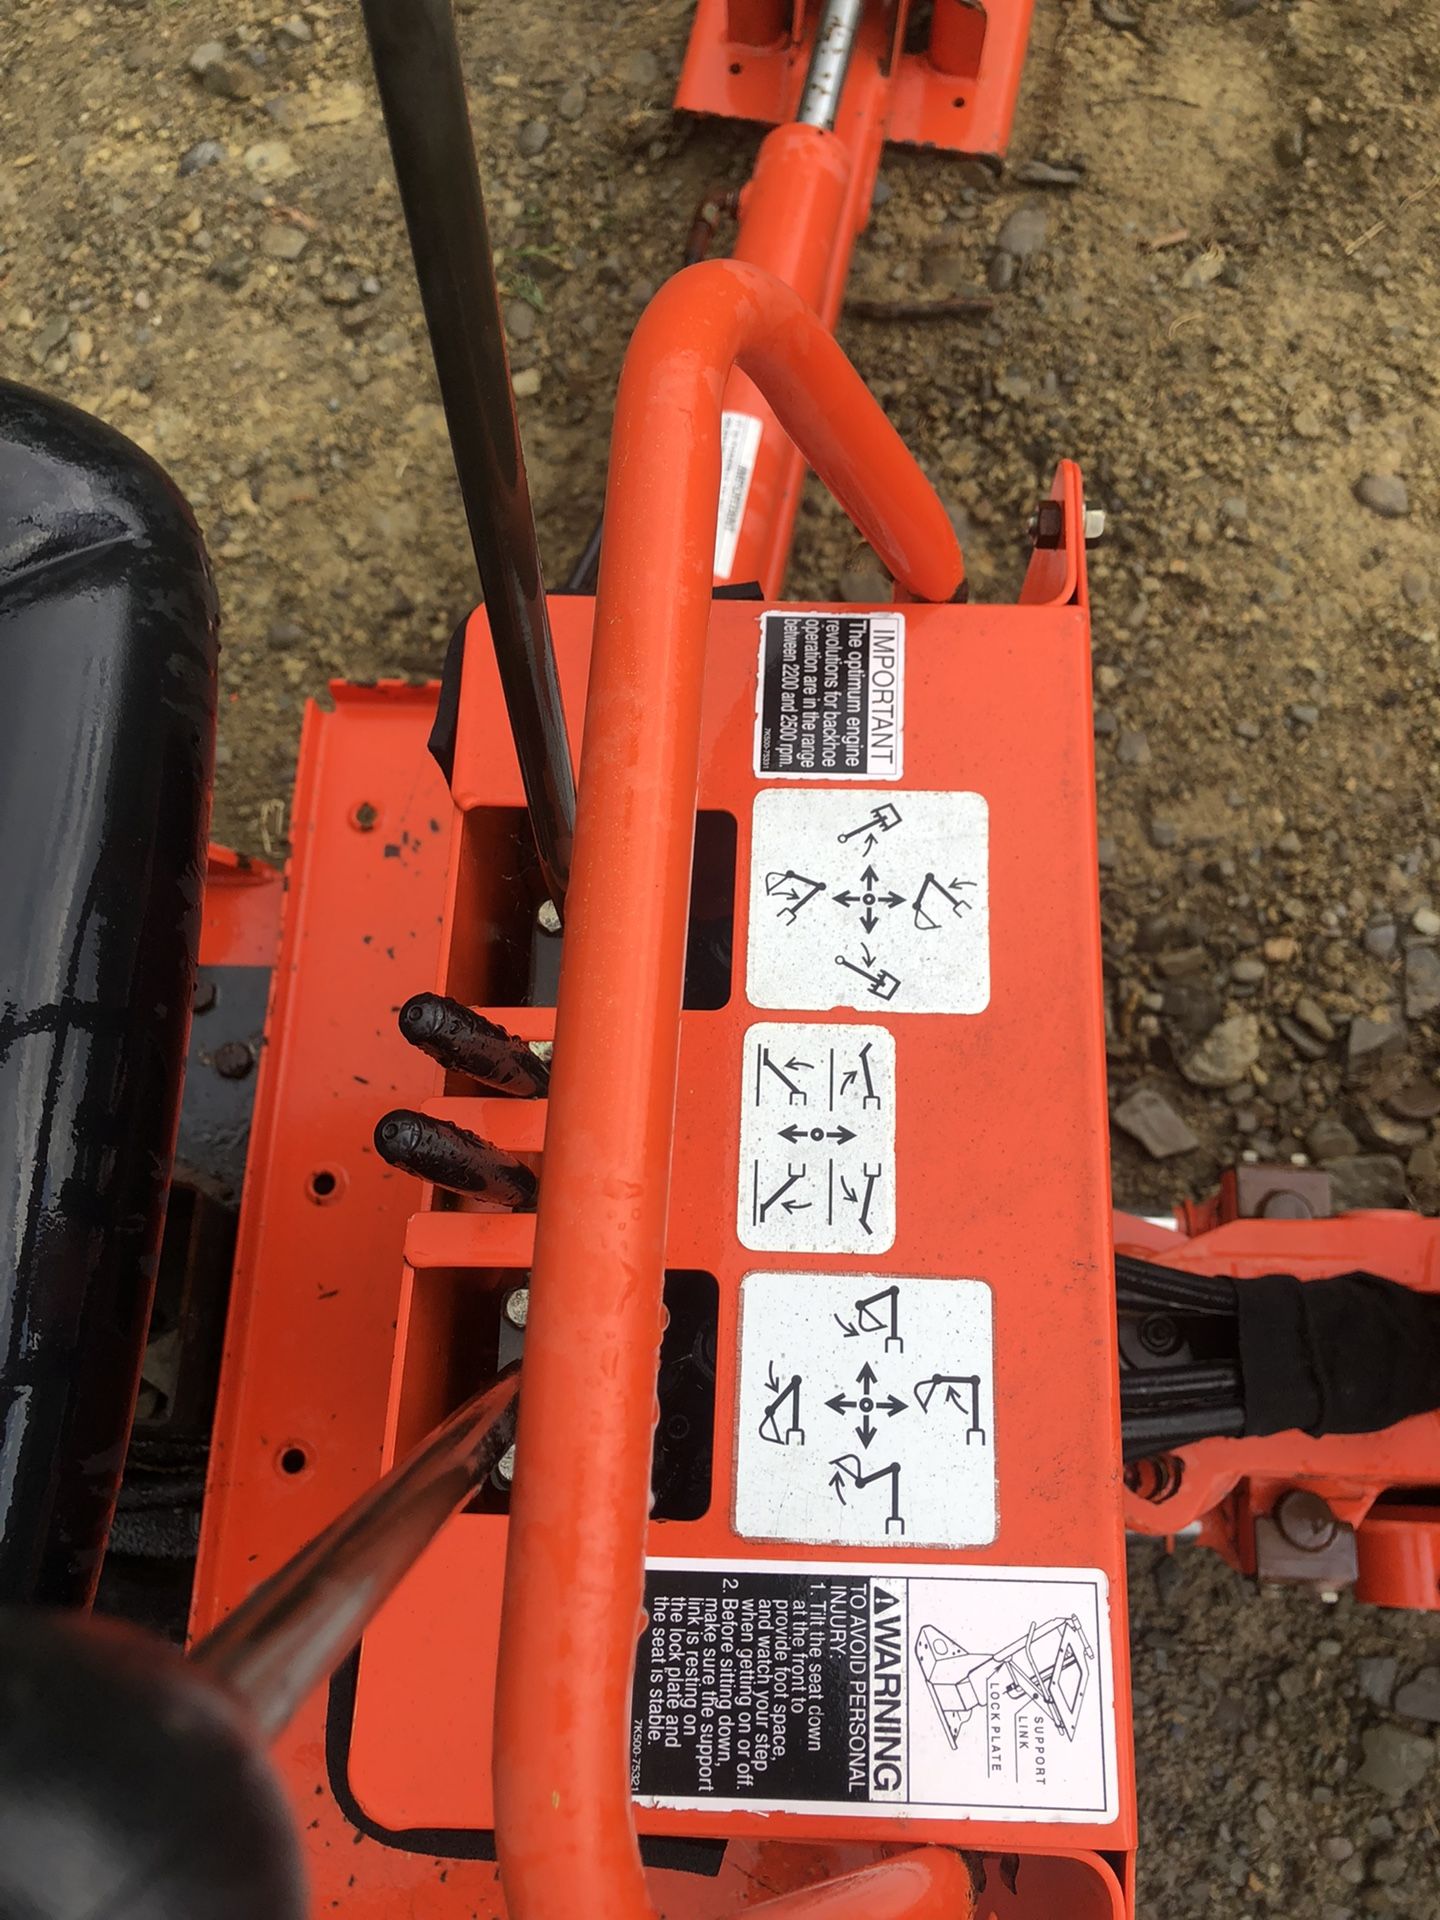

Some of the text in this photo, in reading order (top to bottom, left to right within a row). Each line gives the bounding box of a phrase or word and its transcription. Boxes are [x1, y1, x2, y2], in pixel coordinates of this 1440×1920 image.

[776, 619, 801, 767] between 2200 and 2500 rpm.
[797, 619, 821, 767] operation are in the range
[822, 620, 842, 767] revolutions for backhoe
[842, 621, 867, 766] The optimum engine
[871, 630, 895, 764] IMPORTANT
[647, 1597, 669, 1745] the seat is stable.
[664, 1597, 687, 1747] the lock plate and
[680, 1598, 704, 1735] link is resting on
[696, 1598, 720, 1791] make sure the support
[715, 1579, 738, 1766] 2. Before sitting down,
[735, 1599, 757, 1790] when getting on or off.
[752, 1599, 774, 1771] and watch your step
[770, 1600, 791, 1760] provide foot space,
[791, 1602, 809, 1713] at the front to
[808, 1583, 826, 1751] 1. Tilt the seat down
[830, 1586, 847, 1658] INJURY:
[849, 1584, 866, 1792] TO AVOID PERSONAL
[873, 1615, 901, 1791] WARNING
[990, 1683, 1001, 1771] LOCK PLATE
[1018, 1716, 1029, 1749] LINK
[1034, 1716, 1045, 1784] SUPPORT
